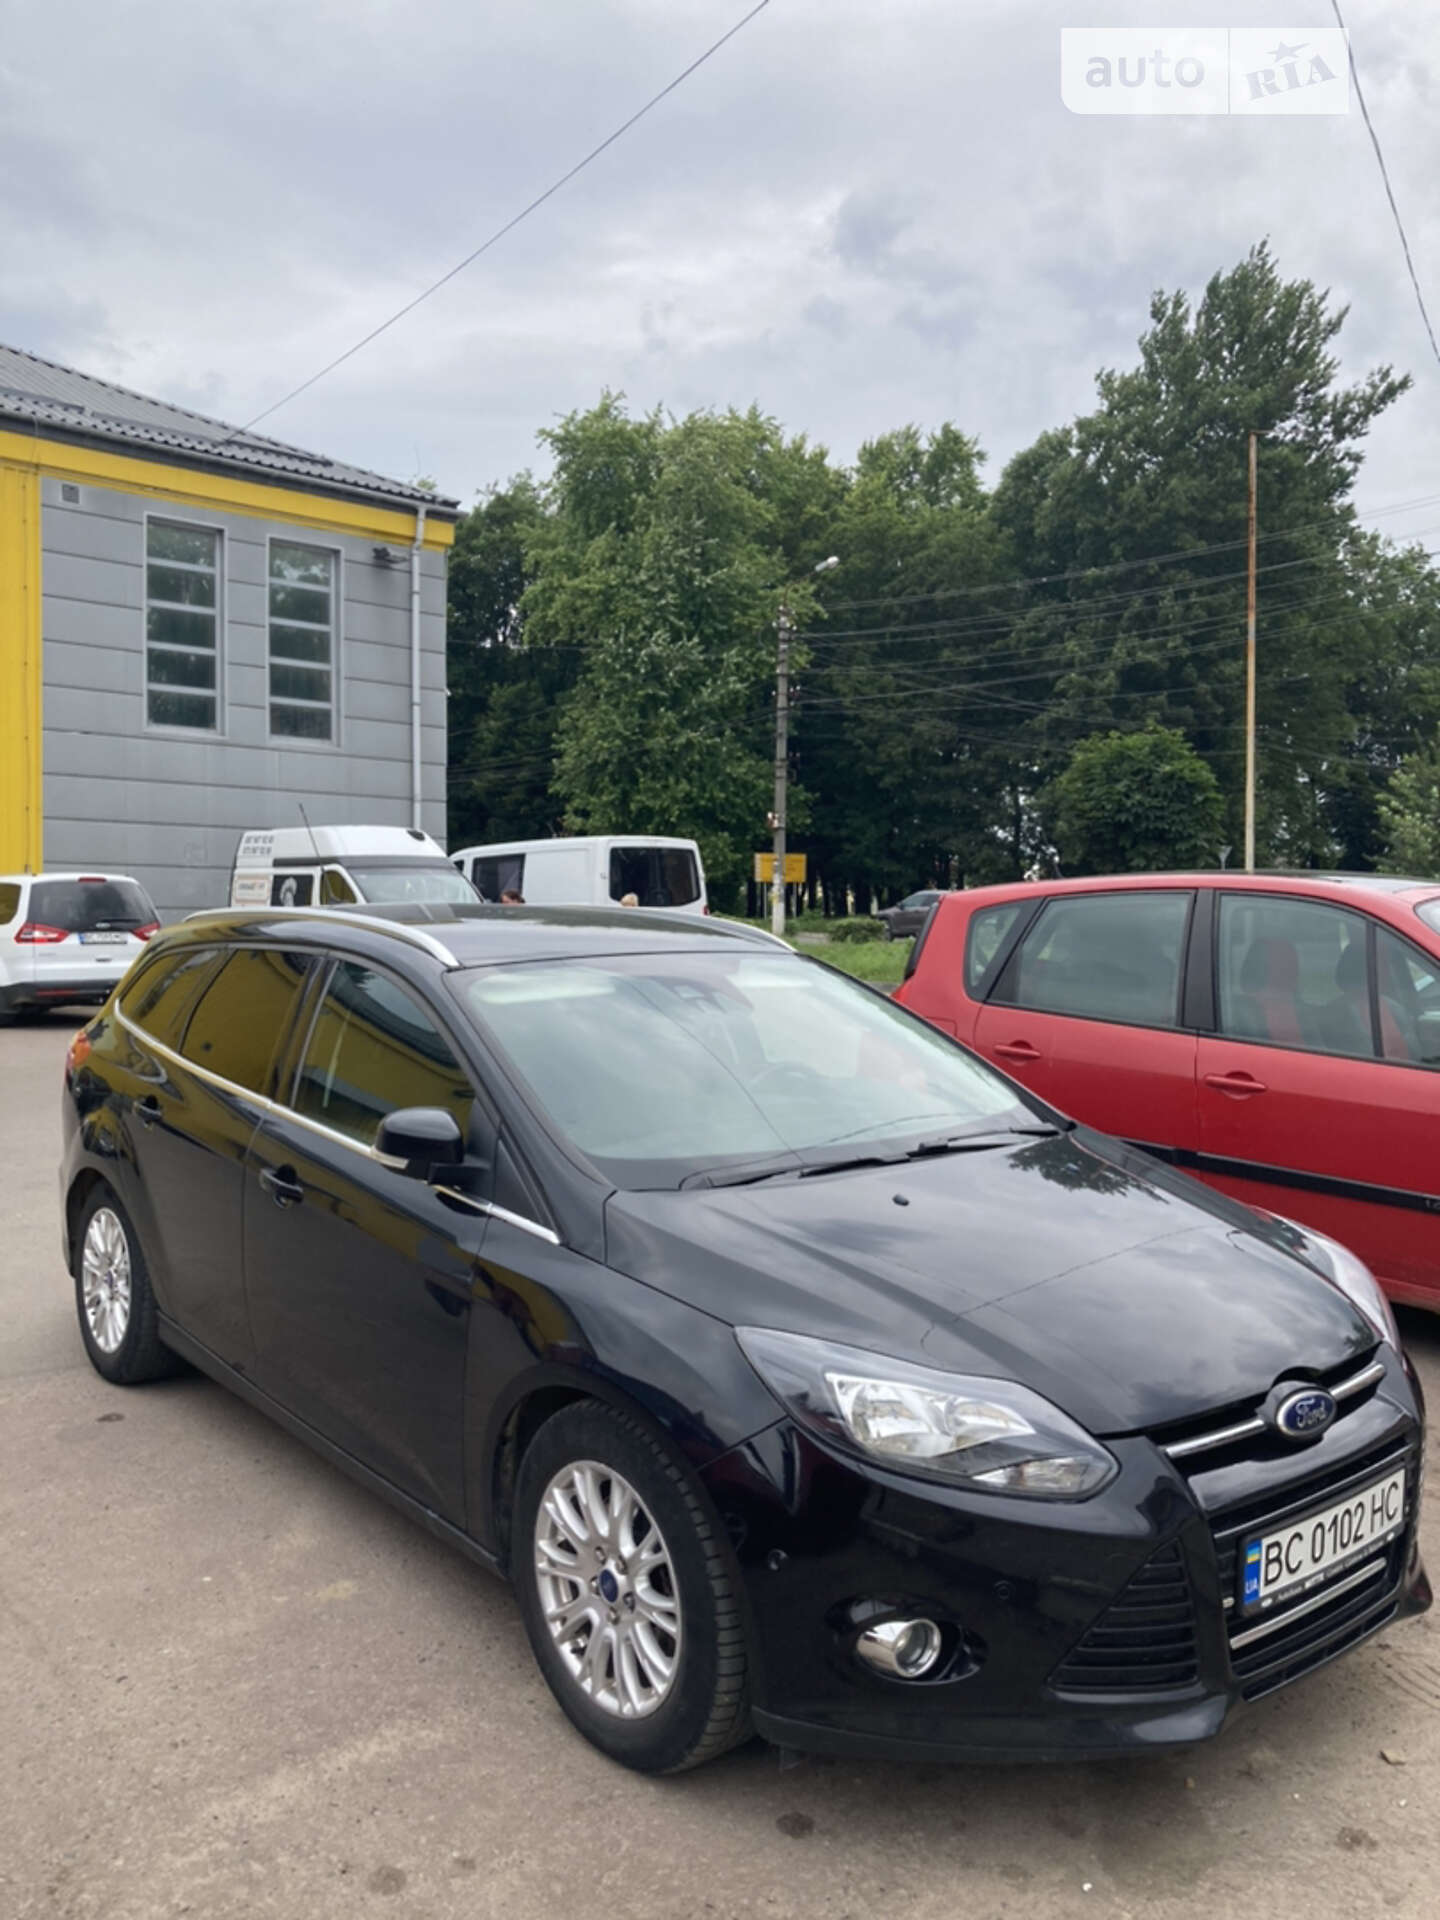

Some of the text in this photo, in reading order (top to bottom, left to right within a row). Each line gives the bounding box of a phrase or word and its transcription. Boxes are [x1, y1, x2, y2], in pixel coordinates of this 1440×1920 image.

[1295, 1397, 1327, 1429] Ford
[1263, 1482, 1398, 1588] BC 0102 HC
[1244, 1577, 1259, 1595] UA
